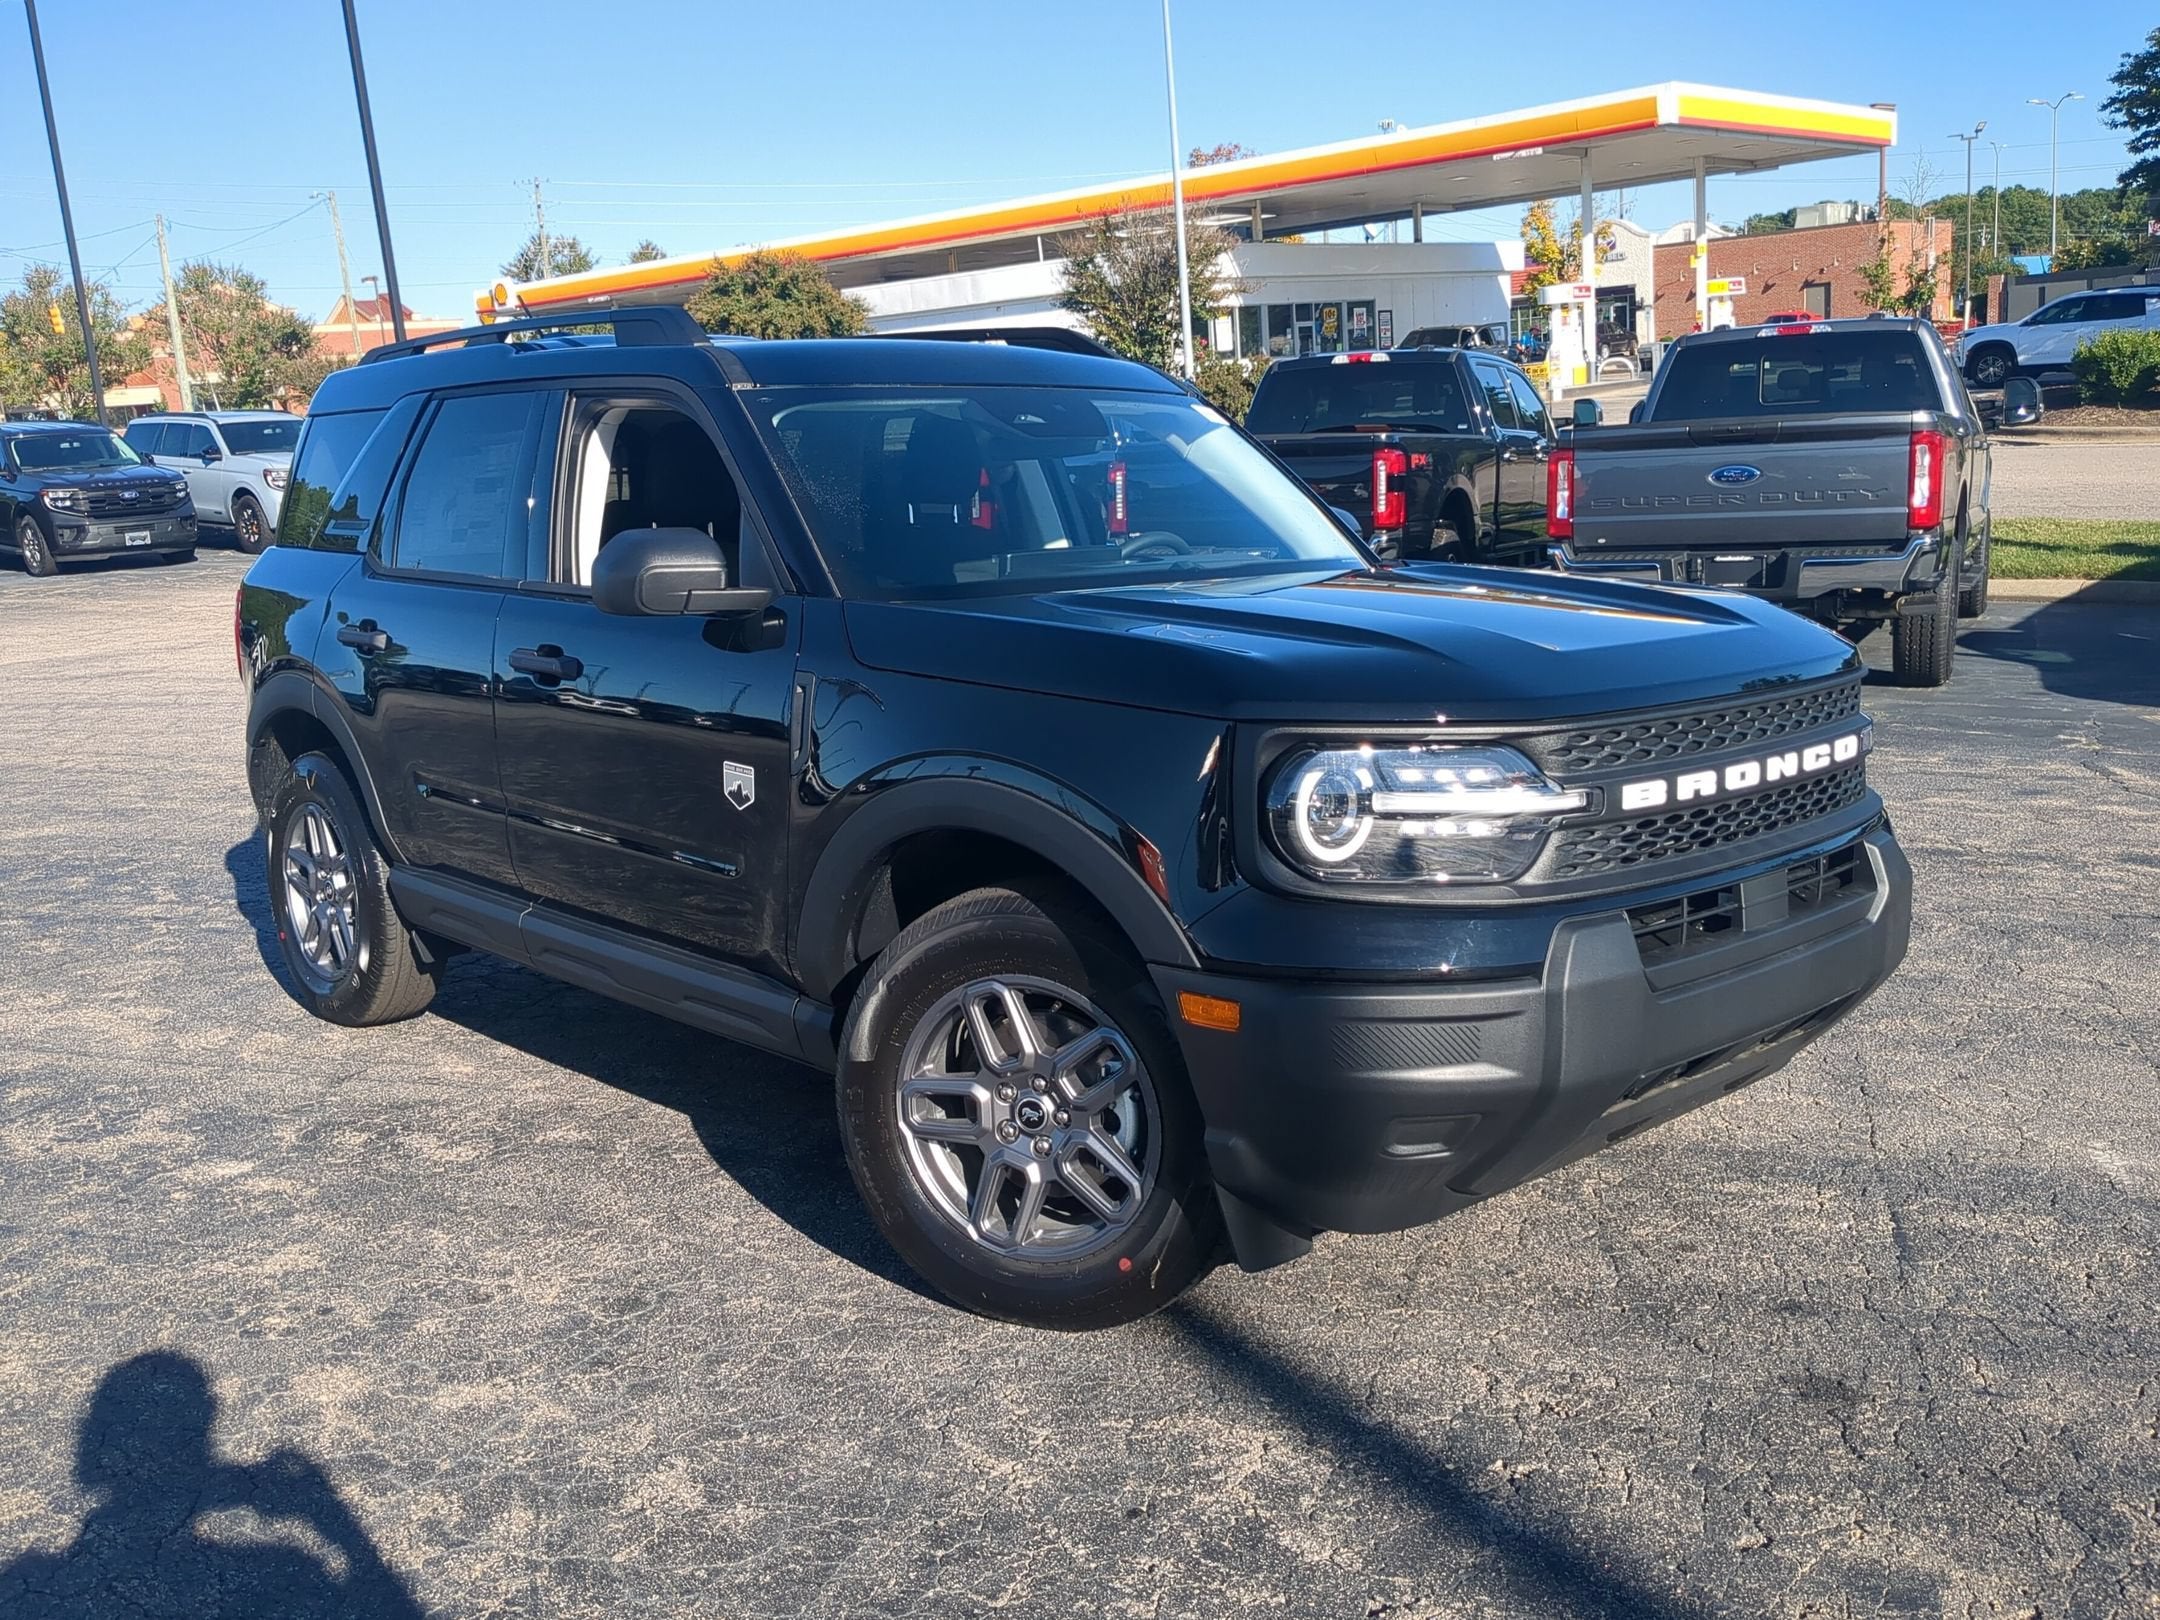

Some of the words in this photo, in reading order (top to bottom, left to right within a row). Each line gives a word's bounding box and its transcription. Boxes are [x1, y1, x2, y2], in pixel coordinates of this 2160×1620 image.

[1591, 493, 1747, 509] SUPER
[1759, 487, 1889, 503] DUTY
[1621, 735, 1859, 810] BRONCO
